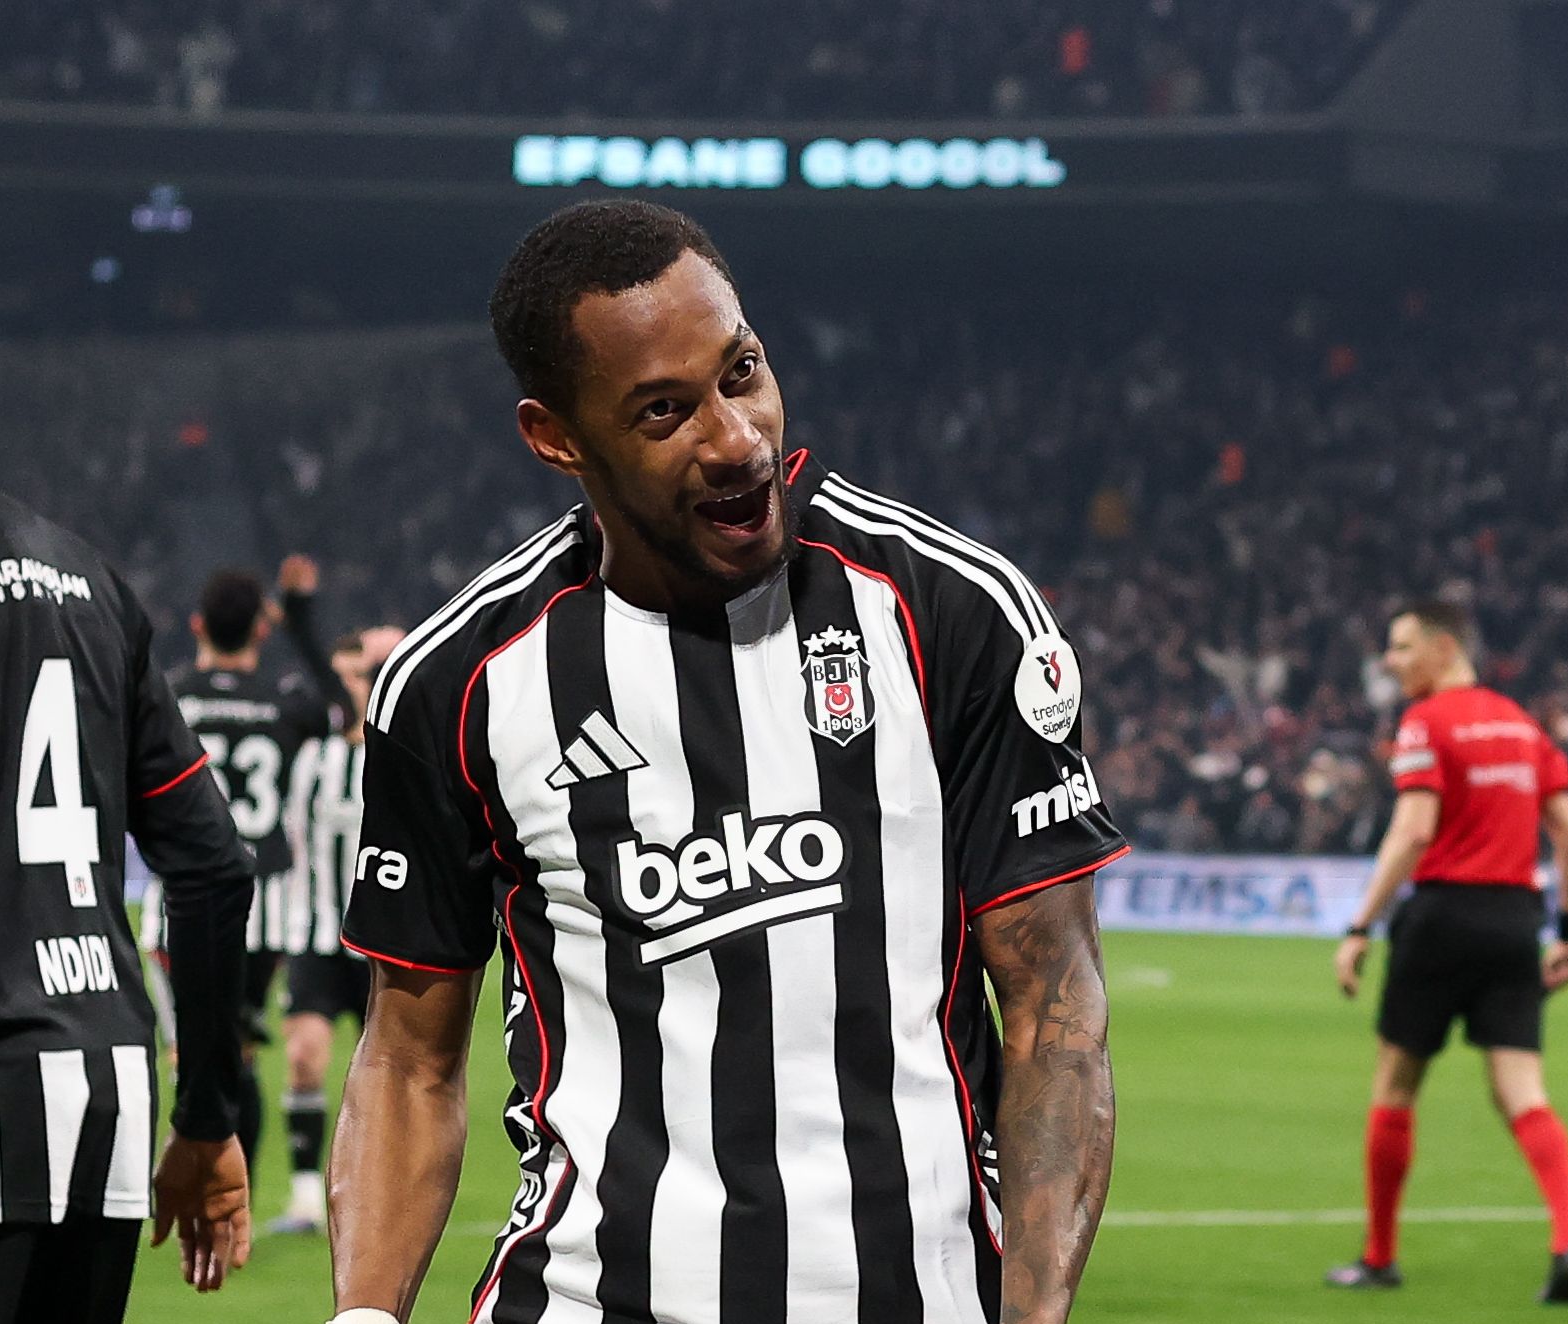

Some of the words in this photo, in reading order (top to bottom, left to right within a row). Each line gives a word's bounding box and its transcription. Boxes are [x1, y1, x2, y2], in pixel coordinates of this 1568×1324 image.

[823, 717, 863, 731] 1903
[1032, 693, 1075, 721] trendyol
[17, 658, 99, 907] 4
[1011, 755, 1102, 838] misl
[617, 811, 844, 914] beko
[35, 935, 119, 996] NDIDI
